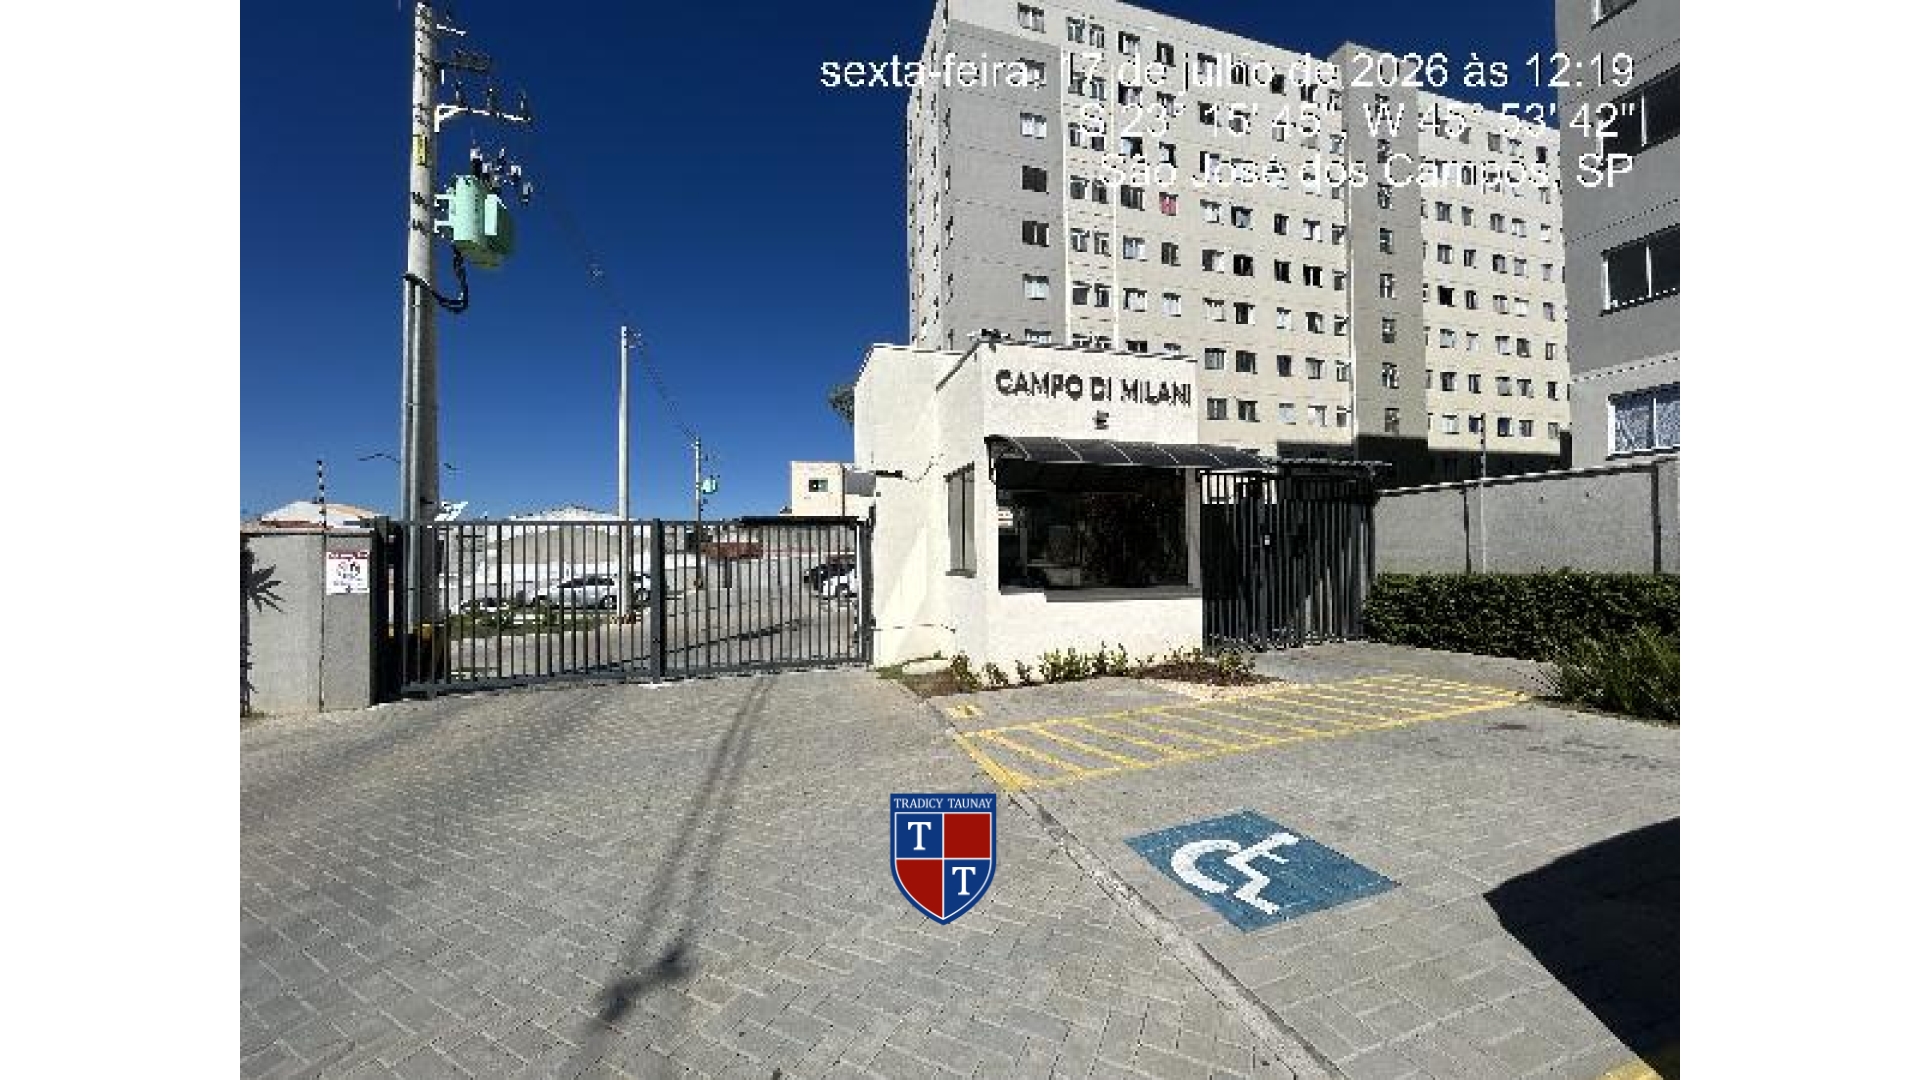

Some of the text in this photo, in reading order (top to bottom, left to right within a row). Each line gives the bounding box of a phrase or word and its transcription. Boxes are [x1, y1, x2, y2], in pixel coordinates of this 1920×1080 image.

[995, 369, 1192, 407] CAMPO DI MILANI
[1093, 410, 1110, 430] E
